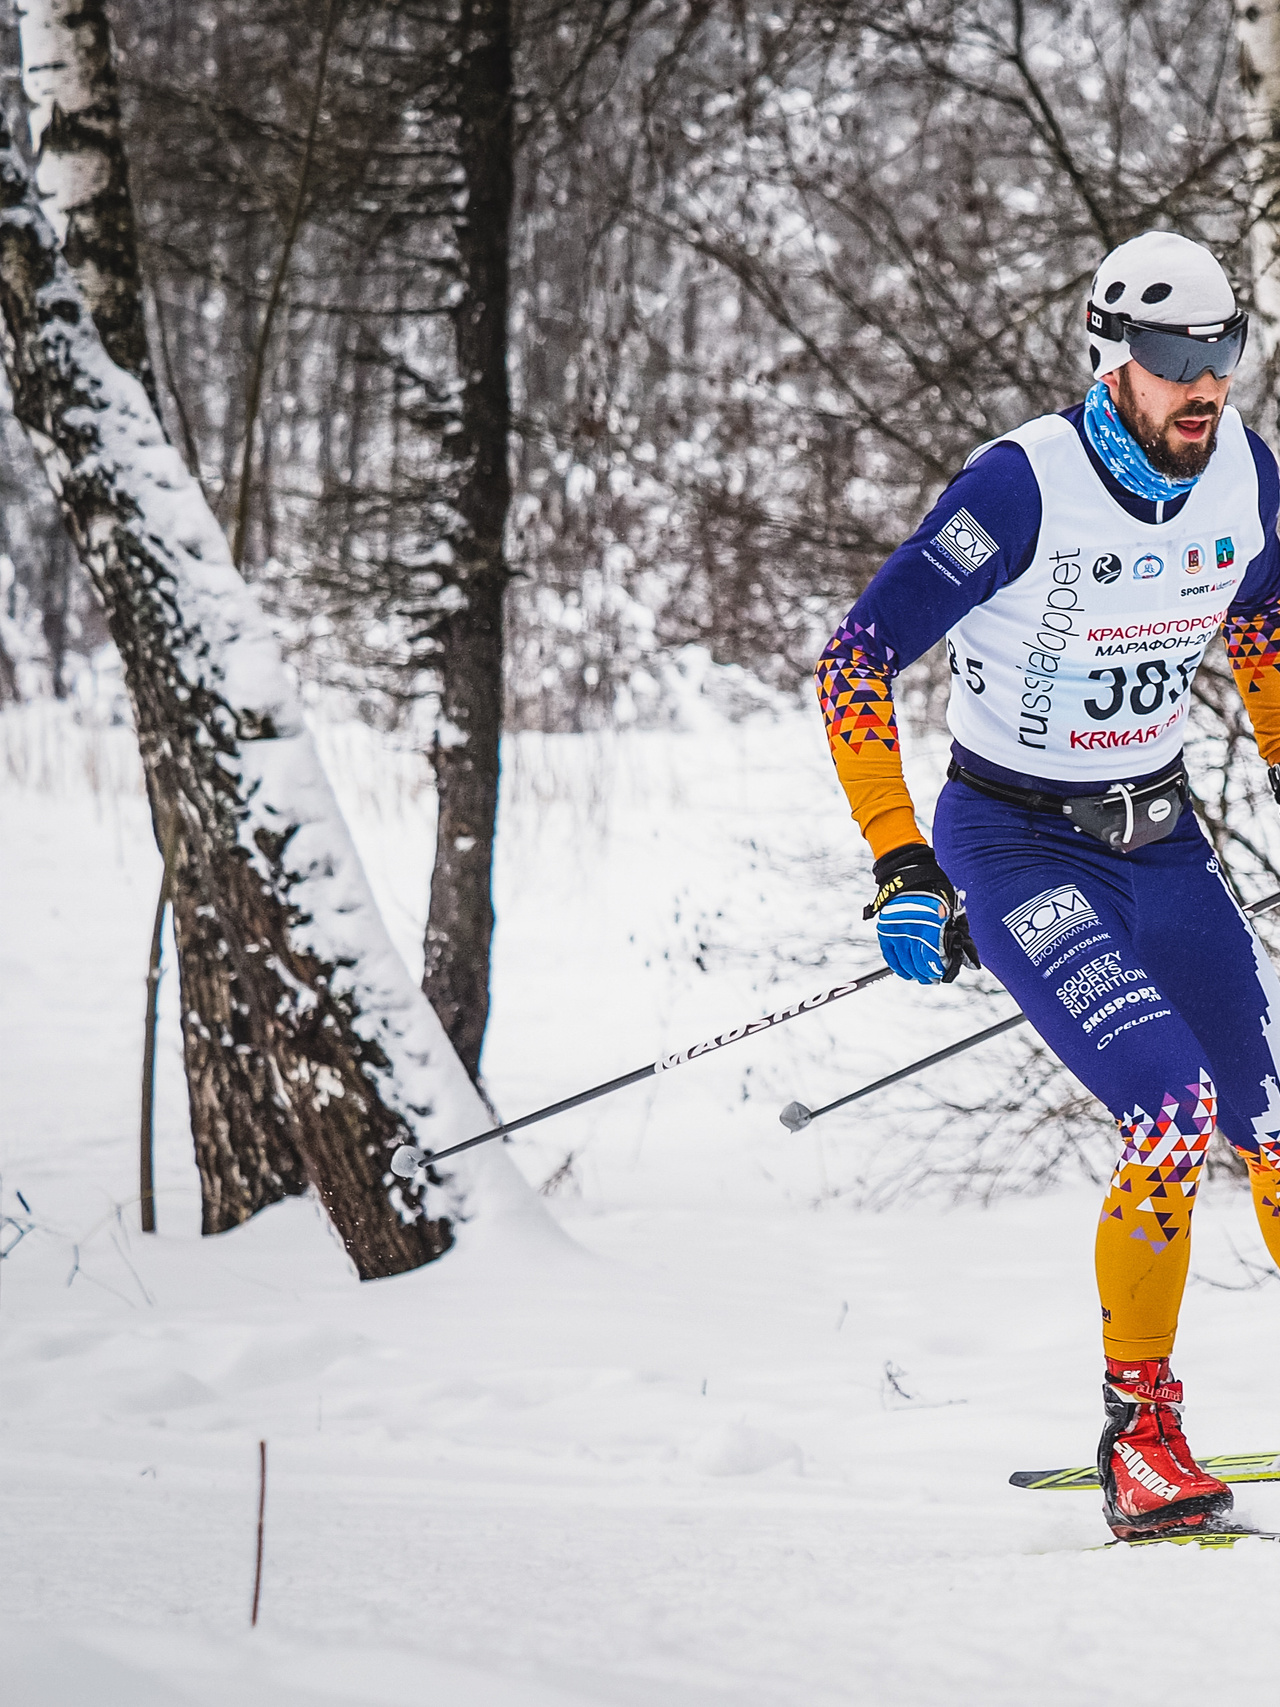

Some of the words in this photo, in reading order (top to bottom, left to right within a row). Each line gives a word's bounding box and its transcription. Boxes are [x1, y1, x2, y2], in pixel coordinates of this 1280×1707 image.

[1180, 584, 1210, 597] SPORT
[1015, 547, 1085, 750] russialoppet
[1095, 629, 1216, 656] МАРАФОН-20
[1084, 651, 1201, 721] 385
[1031, 919, 1103, 967] БИОХИММАК
[1056, 950, 1122, 1000] SQUEEZY
[1063, 963, 1122, 1009] SPORTS
[1069, 968, 1148, 1019] NUTRITION
[1114, 1009, 1172, 1036] PELOTON
[1113, 1441, 1182, 1501] alpina
